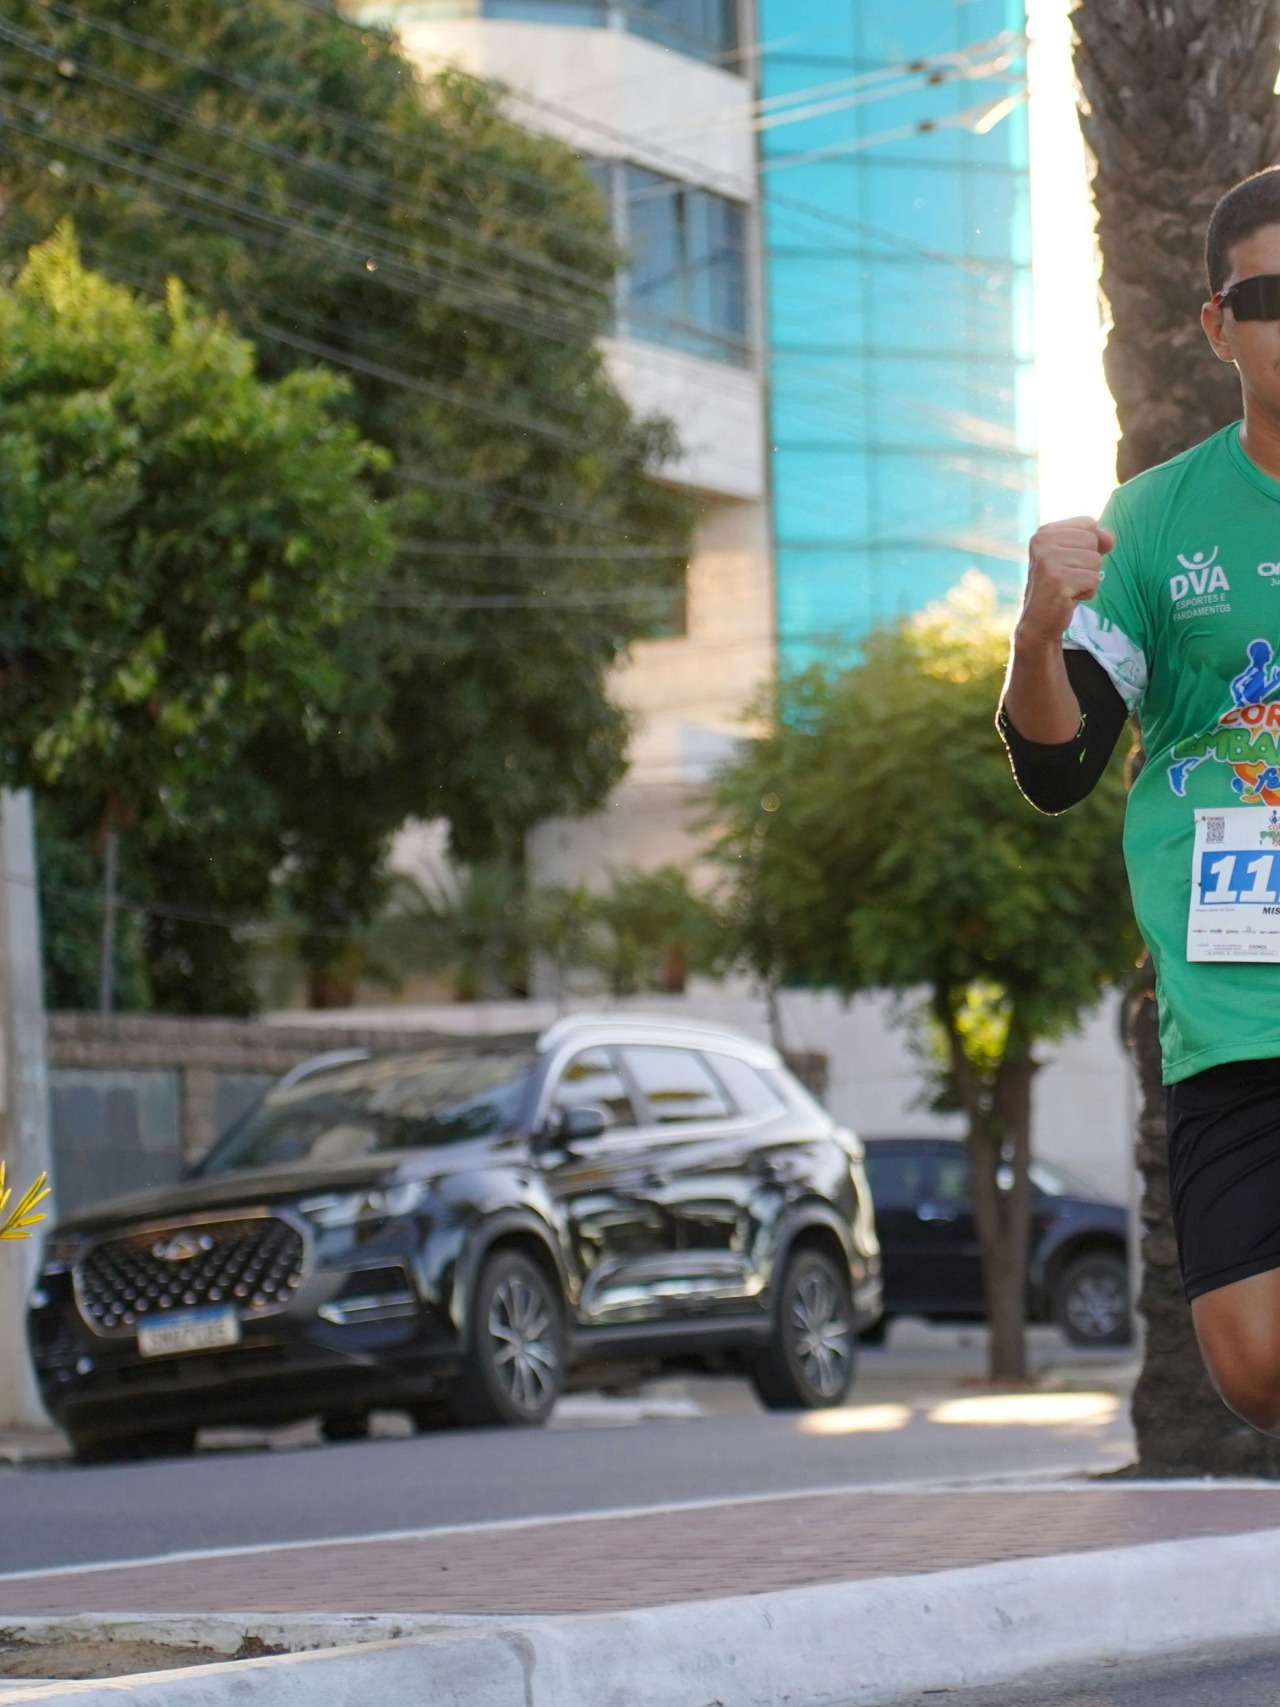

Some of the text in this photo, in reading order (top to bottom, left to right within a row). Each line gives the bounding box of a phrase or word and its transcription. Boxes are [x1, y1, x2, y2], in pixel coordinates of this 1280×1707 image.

[1169, 565, 1230, 602] DVA
[1176, 593, 1227, 611] ESPORTES E
[1173, 603, 1231, 621] FARDAMENTOS
